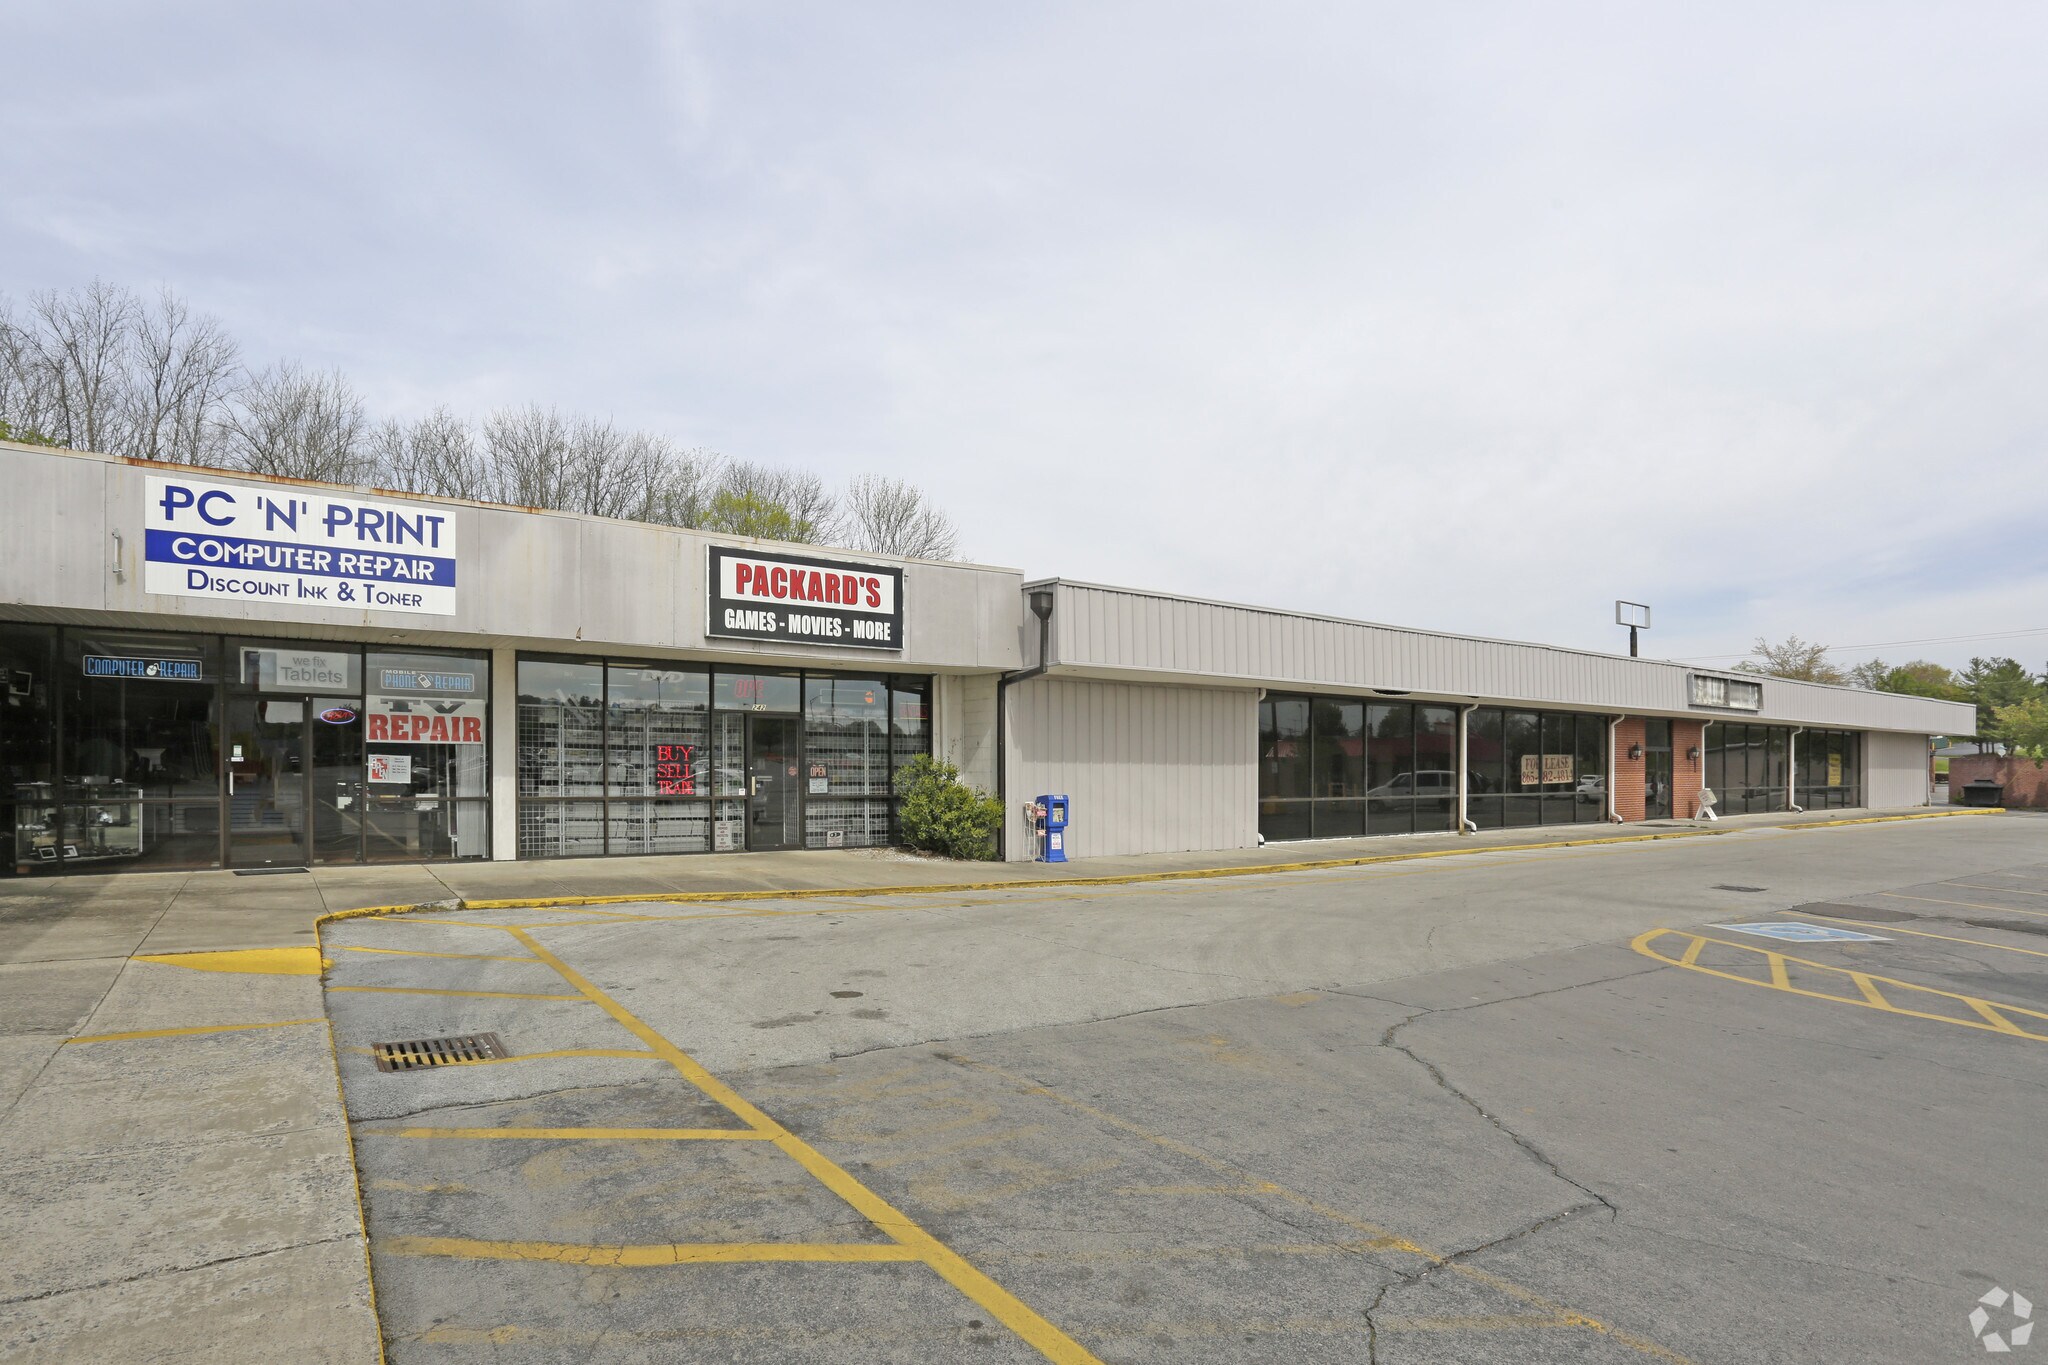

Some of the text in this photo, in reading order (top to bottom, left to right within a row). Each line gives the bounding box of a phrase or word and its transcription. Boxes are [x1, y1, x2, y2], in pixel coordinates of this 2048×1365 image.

[160, 485, 445, 548] PC 'N' PRINT
[171, 537, 436, 581] COMPUTER REPAIR
[338, 582, 356, 603] &
[736, 563, 881, 608] PACKARD'S
[724, 608, 776, 632] GAMES
[788, 614, 842, 637] MOVIES
[853, 620, 891, 641] MORE
[87, 658, 198, 678] COMPUTER REPAIR
[293, 656, 326, 667] we fix
[281, 667, 343, 683] Tablets
[384, 674, 471, 690] PHONE REPAIR
[380, 698, 466, 714] TV
[368, 713, 482, 742] REPAIR
[657, 746, 694, 761] BUY
[657, 764, 691, 778] SELL
[1545, 757, 1570, 769] LEASE
[810, 766, 827, 777] OPEN
[657, 780, 695, 795] TRADE
